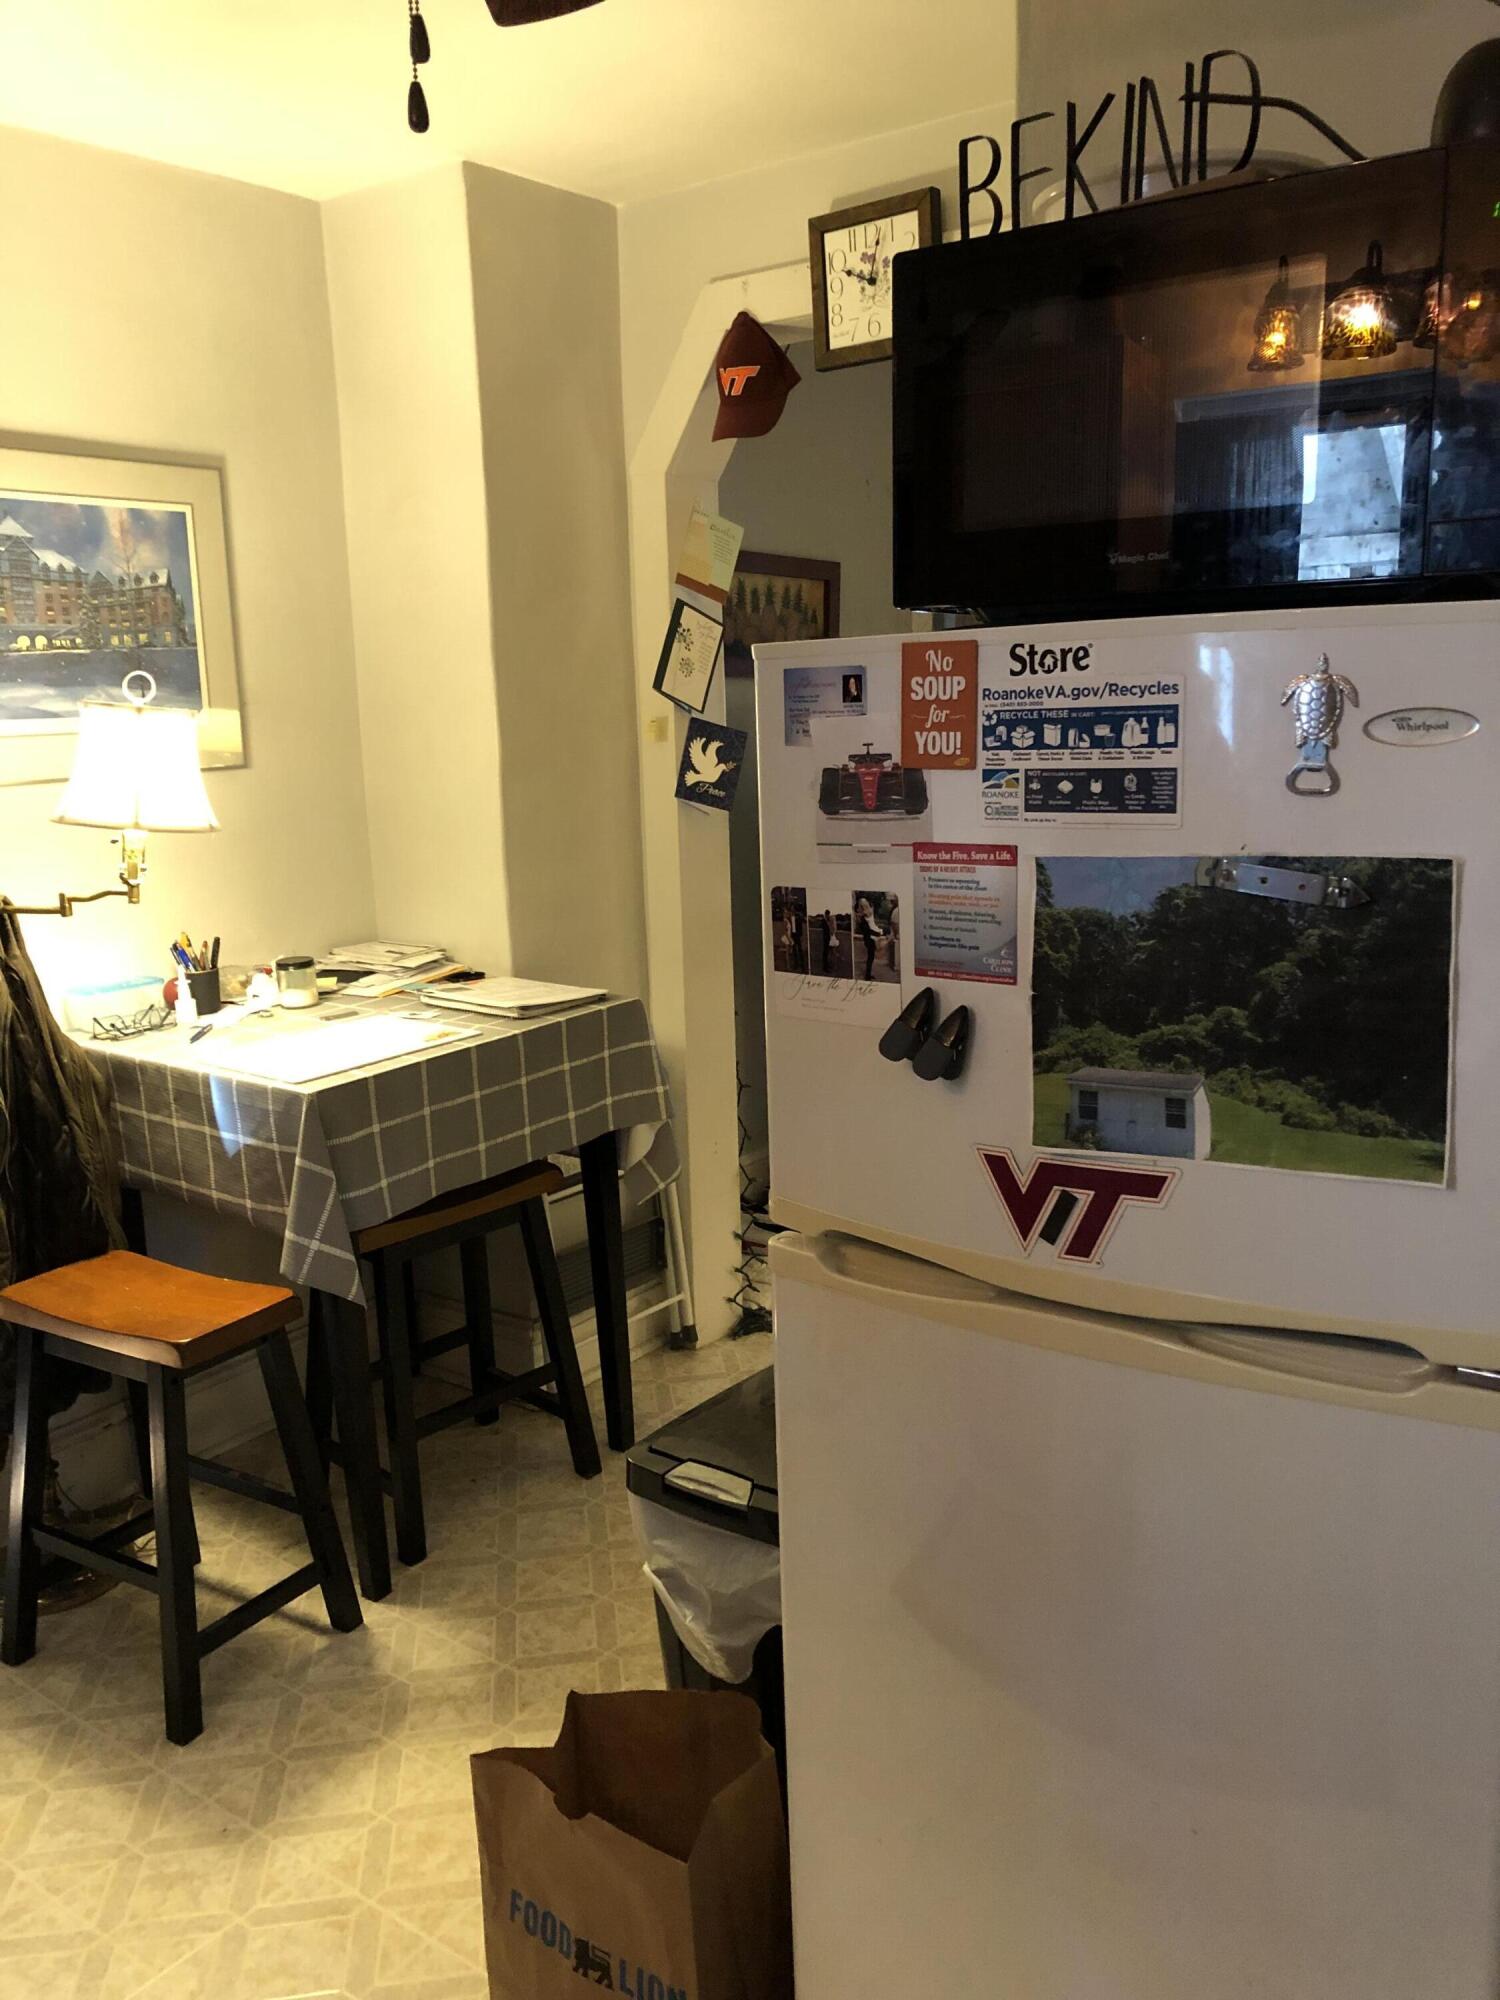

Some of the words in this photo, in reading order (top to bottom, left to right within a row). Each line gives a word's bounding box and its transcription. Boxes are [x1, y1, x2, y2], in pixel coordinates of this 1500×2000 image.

[828, 248, 848, 275] 10
[830, 276, 844, 300] 9
[831, 303, 844, 328] 8
[867, 313, 882, 338] 6
[848, 317, 860, 343] 7
[719, 365, 761, 397] VT
[925, 649, 954, 673] No
[910, 675, 966, 702] SOUP
[982, 680, 1180, 702] RoanokeVA.gov/Recycles
[924, 704, 950, 729] for
[1000, 711, 1039, 720] RECYCLE
[1041, 709, 1070, 719] THESE
[1396, 719, 1449, 733] Whirlpool
[914, 731, 962, 756] YOU!
[982, 790, 1020, 799] ROANOKE
[917, 850, 938, 860] Know
[939, 850, 951, 860] the
[971, 851, 988, 861] Save
[510, 1889, 573, 1961] FOOD
